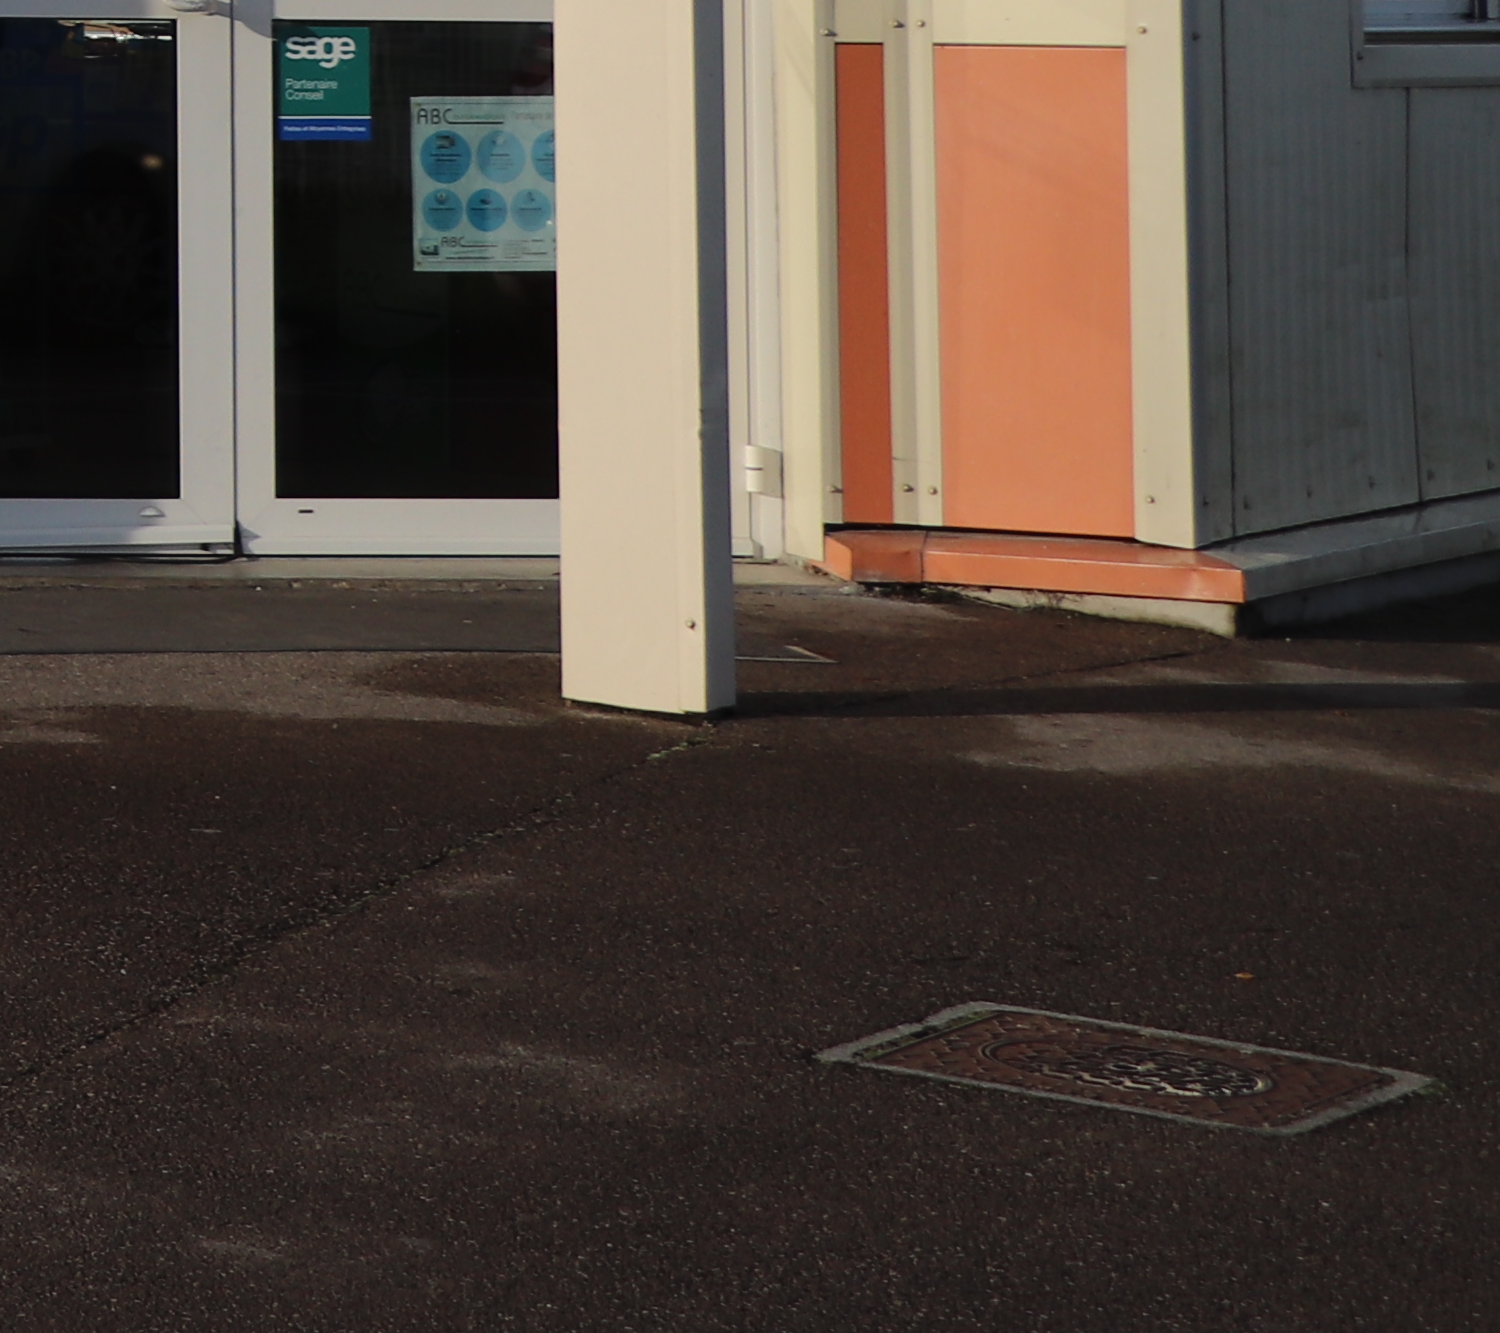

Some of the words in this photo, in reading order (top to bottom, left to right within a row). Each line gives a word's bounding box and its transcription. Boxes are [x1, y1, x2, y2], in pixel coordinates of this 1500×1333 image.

[284, 36, 357, 69] sage
[284, 78, 339, 89] Partenaire
[285, 89, 325, 101] Conseil
[416, 108, 454, 125] ABC
